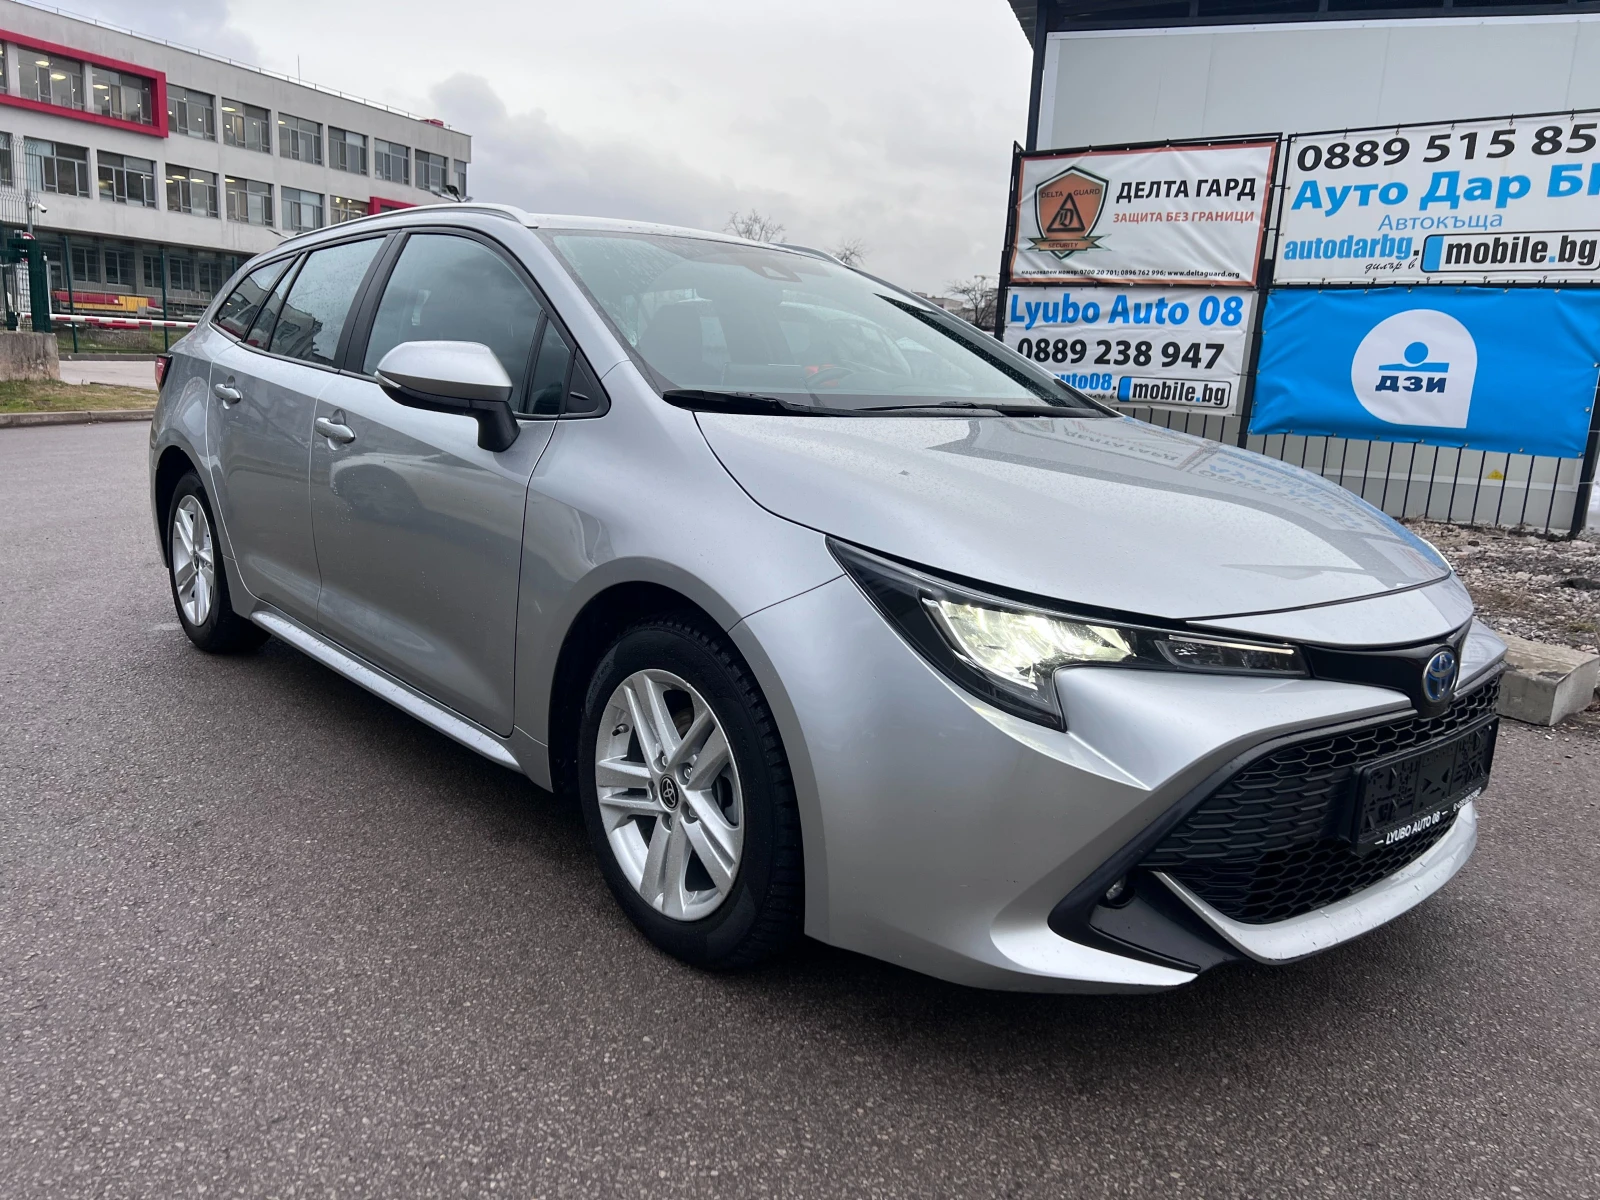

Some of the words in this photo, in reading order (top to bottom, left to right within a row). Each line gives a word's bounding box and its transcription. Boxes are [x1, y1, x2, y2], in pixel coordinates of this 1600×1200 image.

[1297, 137, 1410, 172] 0889
[1422, 128, 1516, 163] 515
[1531, 122, 1598, 156] 85
[1041, 190, 1064, 198] DELTA
[1073, 188, 1100, 196] GUARD
[1115, 180, 1189, 204] ДЕЛТА
[1195, 177, 1256, 202] ГАРД
[1291, 179, 1409, 218] Ауто
[1418, 170, 1532, 211] Дар
[1113, 211, 1163, 224] ЗАЩИТА
[1166, 211, 1189, 222] БЕЗ
[1191, 210, 1255, 223] ГРАНИЦИ
[1378, 214, 1503, 231] Автокъща
[1283, 234, 1420, 260] autodarbg.
[1444, 235, 1597, 266] mobile.bg
[1151, 269, 1166, 277] 996;
[1167, 269, 1240, 279] www.deltaguard.org
[1010, 293, 1101, 330] Lyubo
[1107, 294, 1190, 326] Auto
[1198, 295, 1244, 327] 08
[1018, 337, 1087, 364] 0889
[1094, 339, 1152, 367] 238
[1161, 341, 1225, 370] 947
[1132, 381, 1227, 406] mobile.bg
[1375, 375, 1447, 393] ДЗИ
[1385, 825, 1411, 845] LYUBO
[1411, 815, 1431, 834] AUTO
